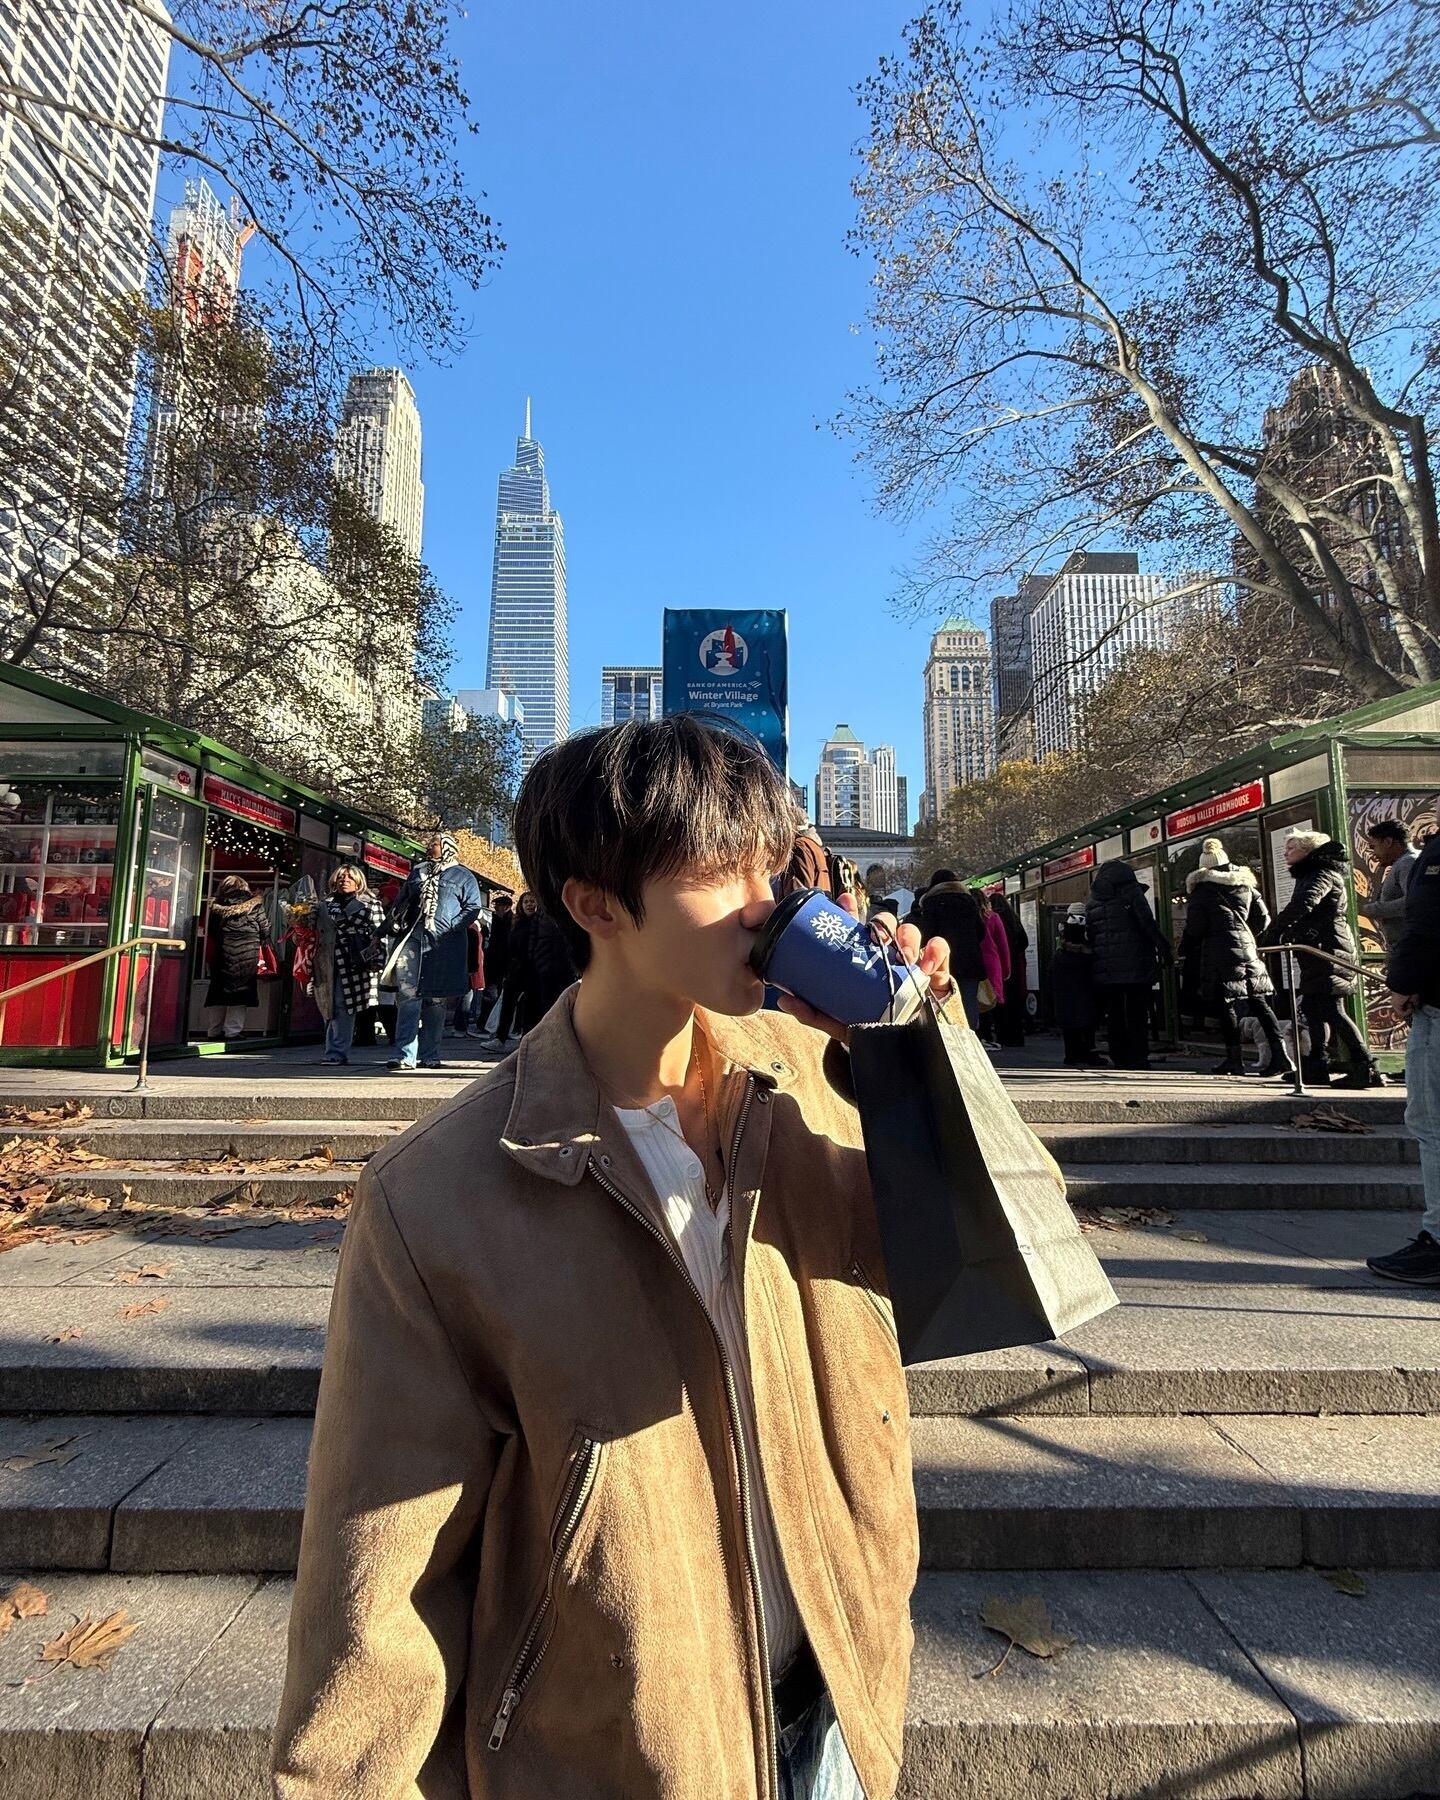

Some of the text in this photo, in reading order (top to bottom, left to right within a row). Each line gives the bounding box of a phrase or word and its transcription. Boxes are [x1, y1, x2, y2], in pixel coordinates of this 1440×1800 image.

[688, 691, 758, 702] Winter Village
[1176, 793, 1250, 829] HUDSON VALLEY FARMHOUSE
